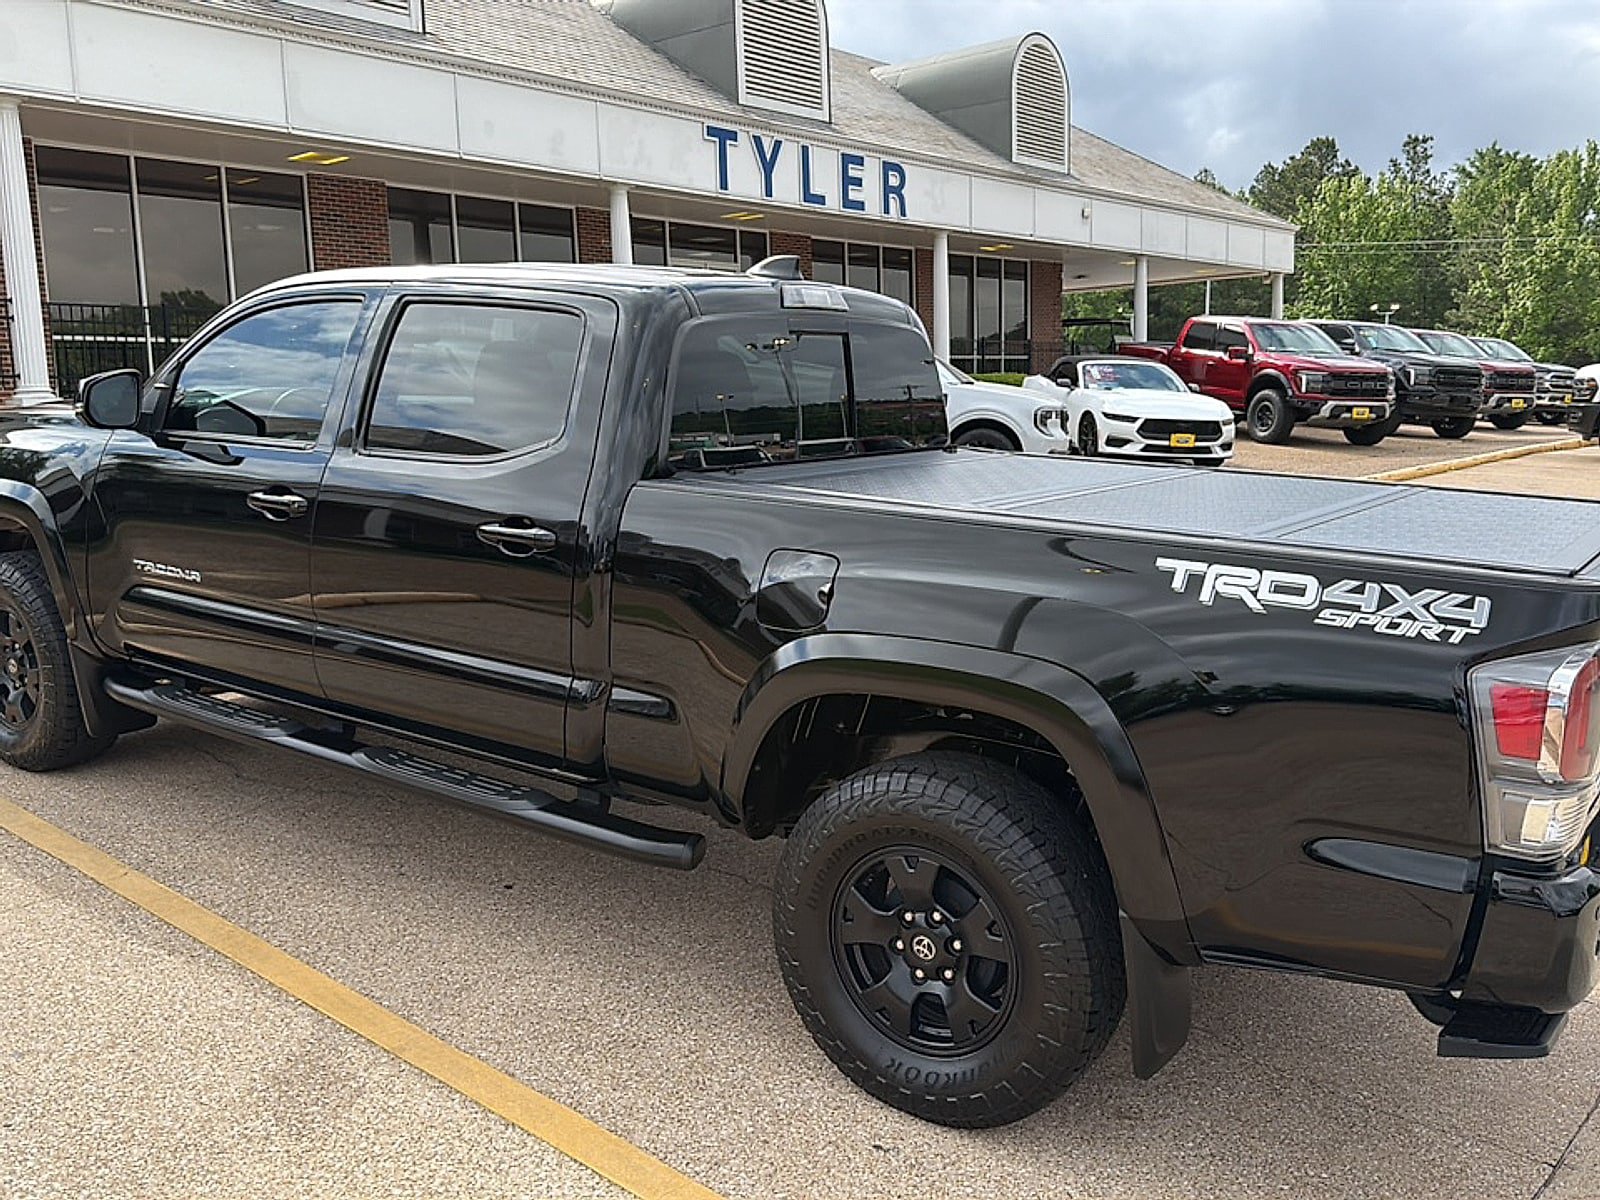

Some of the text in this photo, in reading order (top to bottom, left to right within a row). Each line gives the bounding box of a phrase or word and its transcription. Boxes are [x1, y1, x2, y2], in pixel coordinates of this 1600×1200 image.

[705, 124, 908, 218] TYLER
[132, 559, 202, 582] TACOMA
[1313, 608, 1482, 644] SPORT
